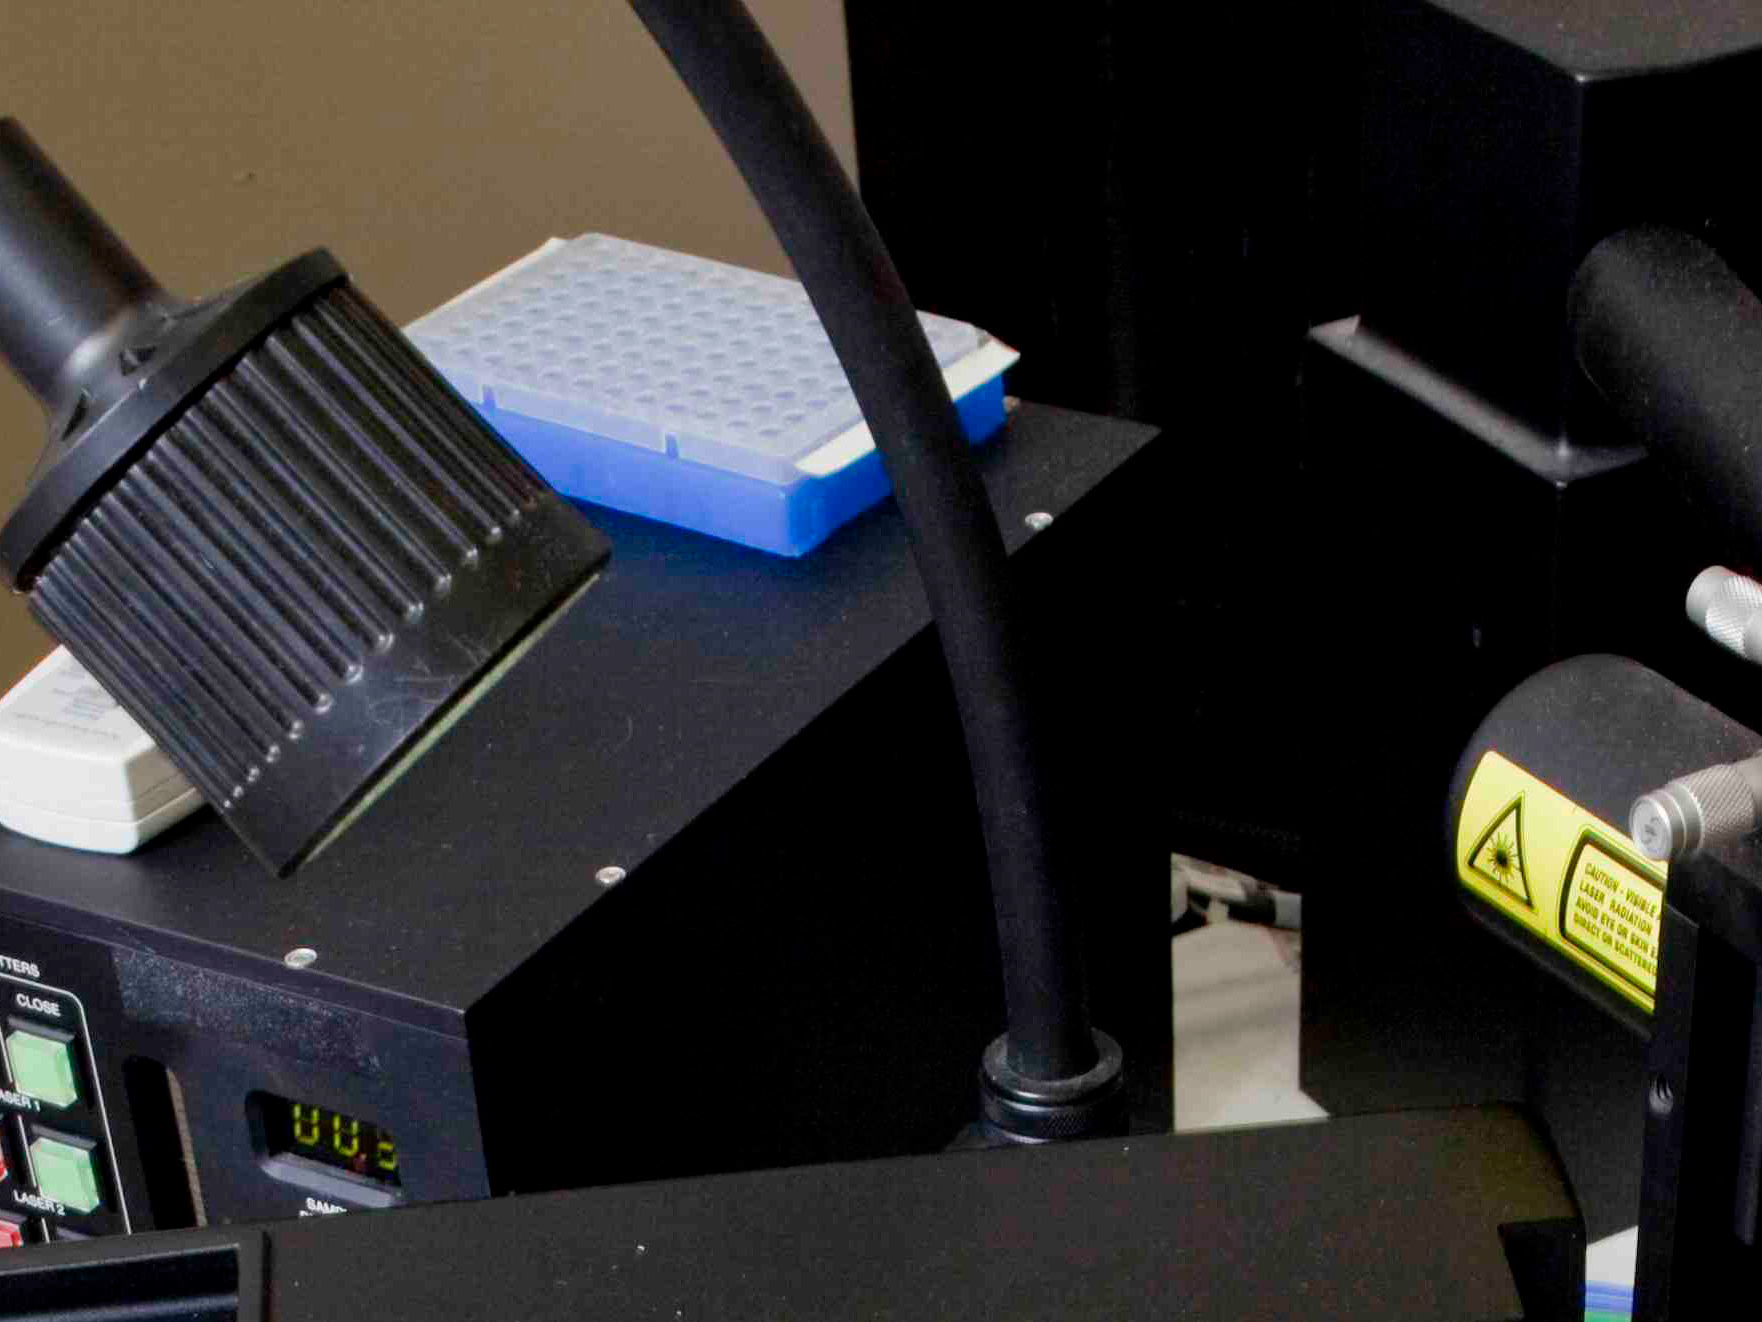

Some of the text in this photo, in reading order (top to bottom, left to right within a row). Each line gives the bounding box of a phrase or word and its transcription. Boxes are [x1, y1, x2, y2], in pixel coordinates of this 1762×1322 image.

[1579, 879, 1653, 936] LASER RADIATION
[1585, 863, 1620, 893] CAUTION
[1625, 888, 1658, 919] VISIBLE
[1573, 911, 1600, 938] DIRECT
[1576, 895, 1599, 919] AVOID
[1630, 931, 1649, 952] SKIN
[16, 993, 61, 1017] CLOSE
[13, 1189, 66, 1217] LASER 2
